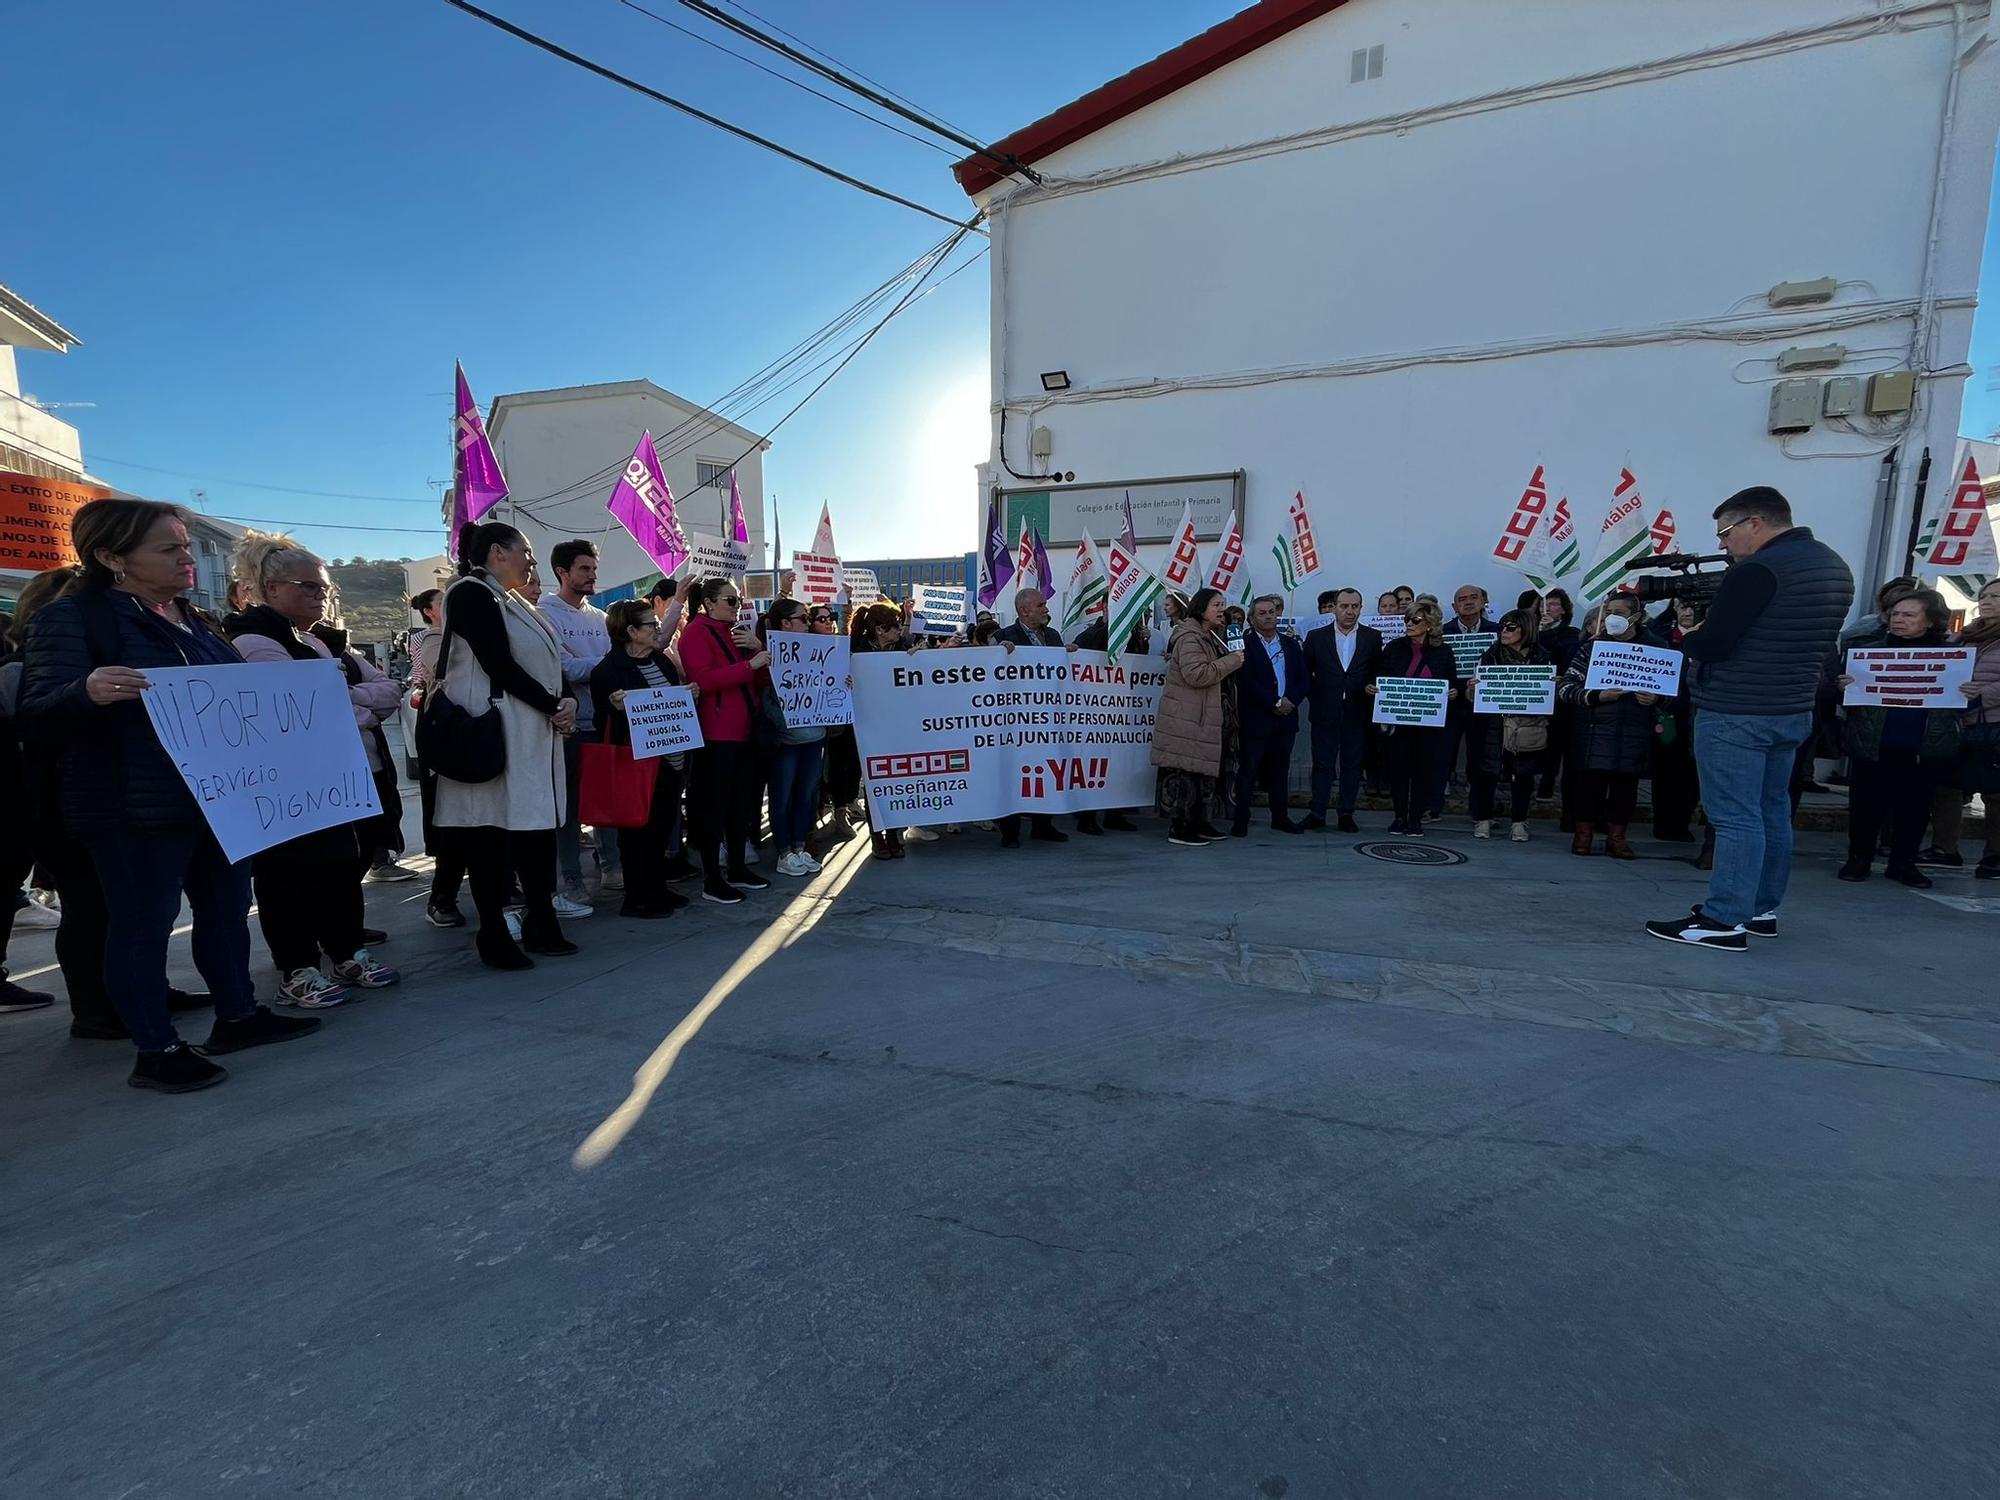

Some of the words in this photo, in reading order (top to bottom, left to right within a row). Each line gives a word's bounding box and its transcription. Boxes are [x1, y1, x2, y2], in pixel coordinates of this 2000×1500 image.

[10, 482, 52, 498] ÉXITO
[55, 491, 71, 502] DE
[28, 502, 73, 517] BUENA
[1076, 504, 1103, 514] Colegio
[1104, 502, 1113, 511] de
[1115, 501, 1152, 511] Edcación
[1601, 492, 1642, 533] Málag
[0, 531, 36, 544] NOS
[41, 535, 60, 546] DE
[62, 537, 75, 546] L
[723, 540, 732, 548] LA
[0, 547, 25, 558] DE
[692, 556, 703, 565] DE
[1111, 567, 1141, 602] Málaga
[809, 646, 836, 668] UN
[1598, 651, 1674, 668] ALIMENTACIÓN
[893, 667, 924, 687] En
[931, 665, 987, 685] este
[994, 663, 1067, 681] centro
[1071, 663, 1126, 685] FALTA
[1607, 661, 1677, 677] NUESTROS/AS
[1614, 680, 1661, 690] PRIMERO
[652, 690, 663, 698] LA
[971, 692, 1062, 708] COBERTURA
[1065, 693, 1082, 706] DE
[1083, 694, 1143, 708] VACANTES
[1146, 697, 1153, 708] Y
[273, 690, 317, 733] UN
[630, 718, 642, 727] DE
[643, 711, 694, 725] NUESTROS/AS
[922, 711, 1049, 732] SUSTITUCIONES
[1053, 712, 1066, 725] DE
[1069, 712, 1131, 726] PERSONAL
[645, 741, 656, 750] LO
[656, 735, 691, 748] PRIMERO
[974, 734, 995, 748] DE
[999, 732, 1014, 746] LA
[1017, 731, 1065, 747] JUNTA
[1066, 731, 1083, 744] DE
[1085, 728, 1153, 745] ANDALUCÍA
[870, 753, 947, 777] CCOO
[1021, 757, 1109, 798] ¡¡YA!!
[873, 778, 969, 798] enseñanza
[889, 794, 954, 811] málaga
